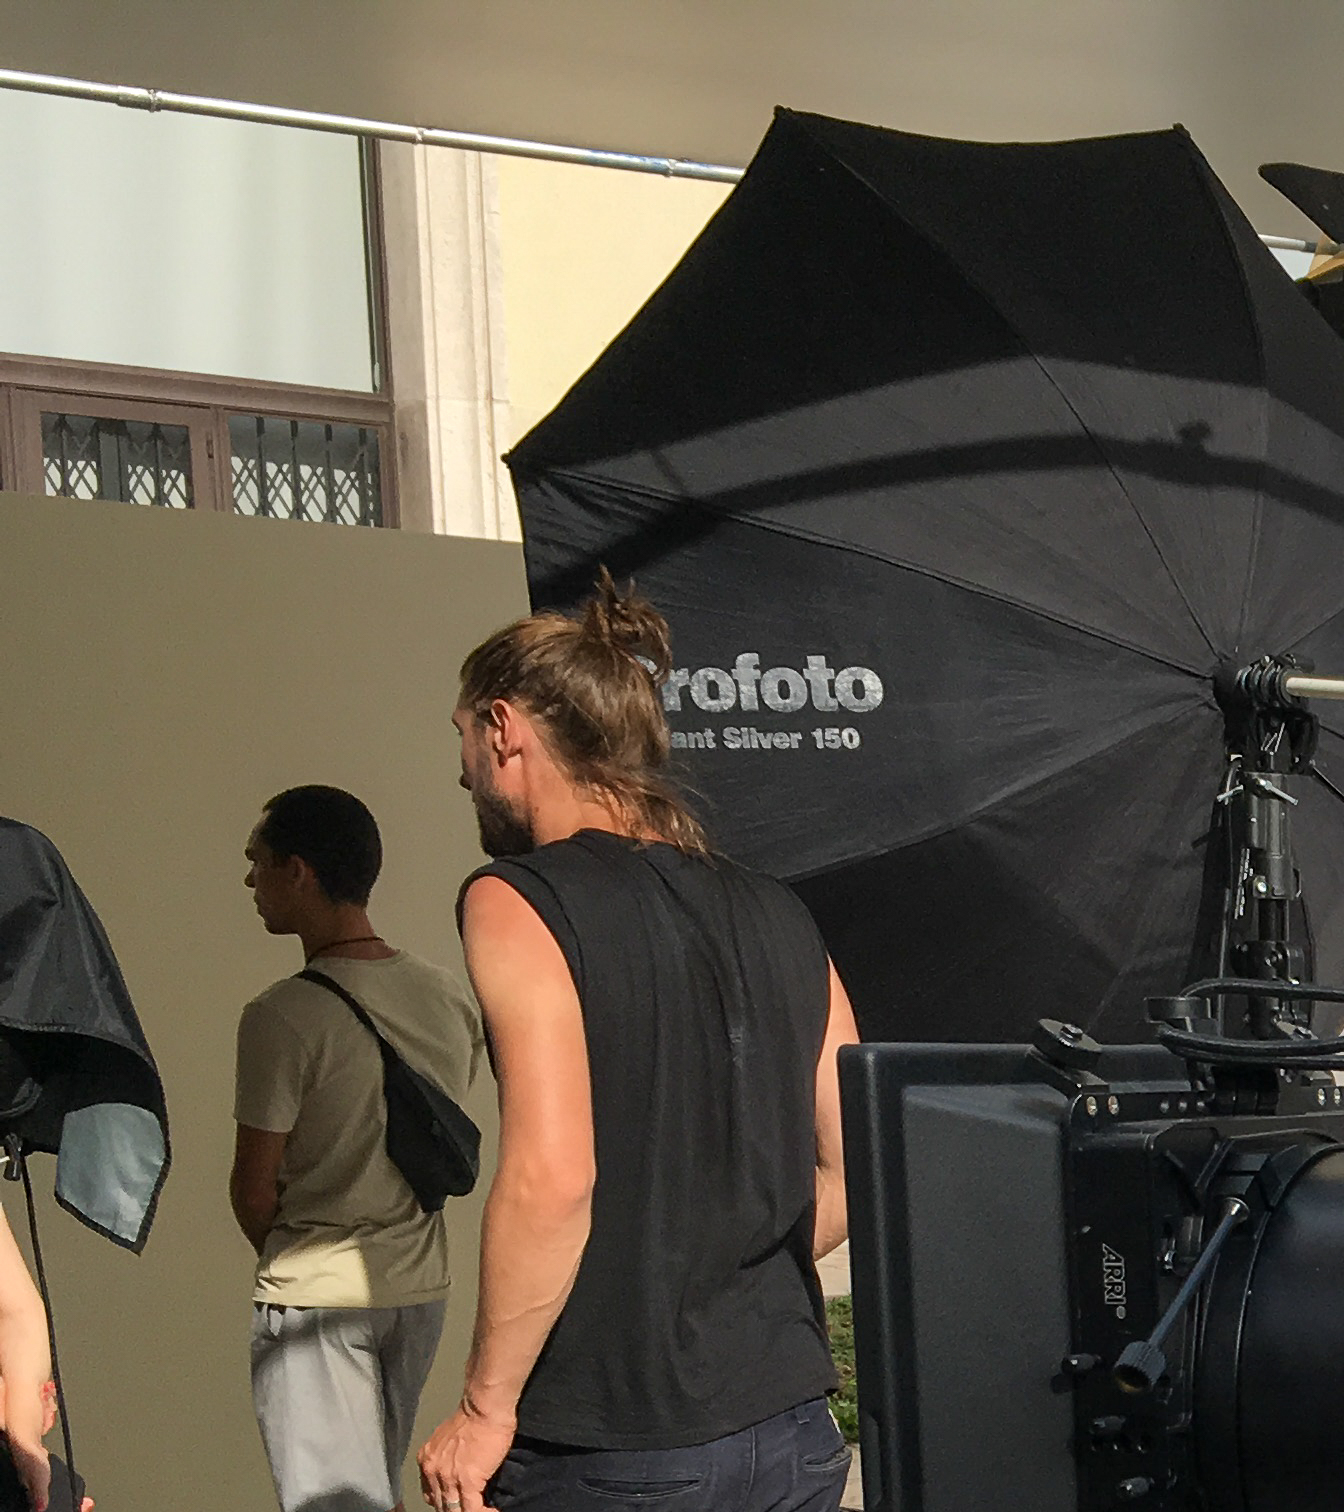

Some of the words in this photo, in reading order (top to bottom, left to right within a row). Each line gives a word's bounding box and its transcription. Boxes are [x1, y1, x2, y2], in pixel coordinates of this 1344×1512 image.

[645, 652, 885, 713] rofoto
[722, 726, 803, 749] Silver
[811, 727, 861, 749] 150
[1102, 1243, 1127, 1305] ARRI
